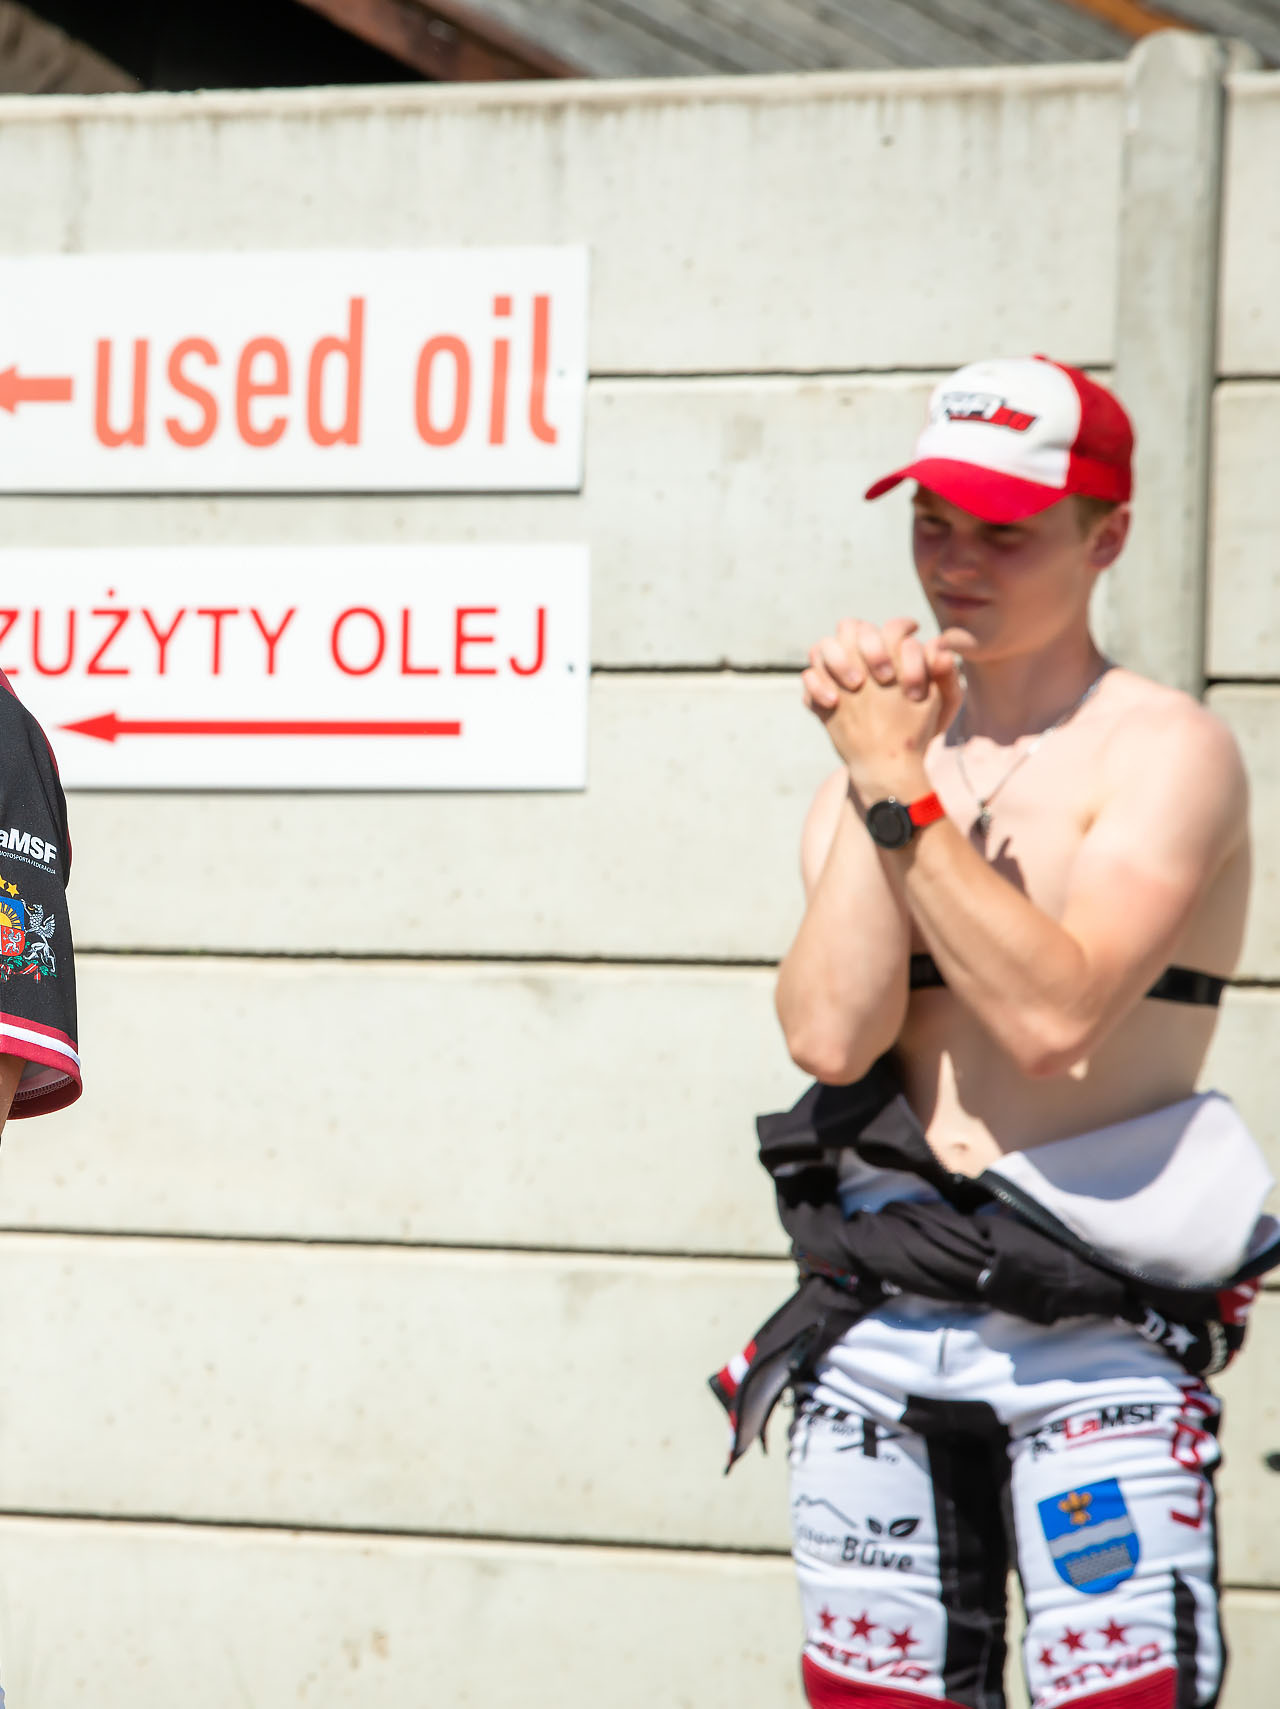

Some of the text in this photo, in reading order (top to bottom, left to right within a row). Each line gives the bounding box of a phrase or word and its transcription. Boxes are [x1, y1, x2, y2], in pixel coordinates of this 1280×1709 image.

[93, 294, 560, 447] used oil
[330, 606, 547, 676] OLEJ
